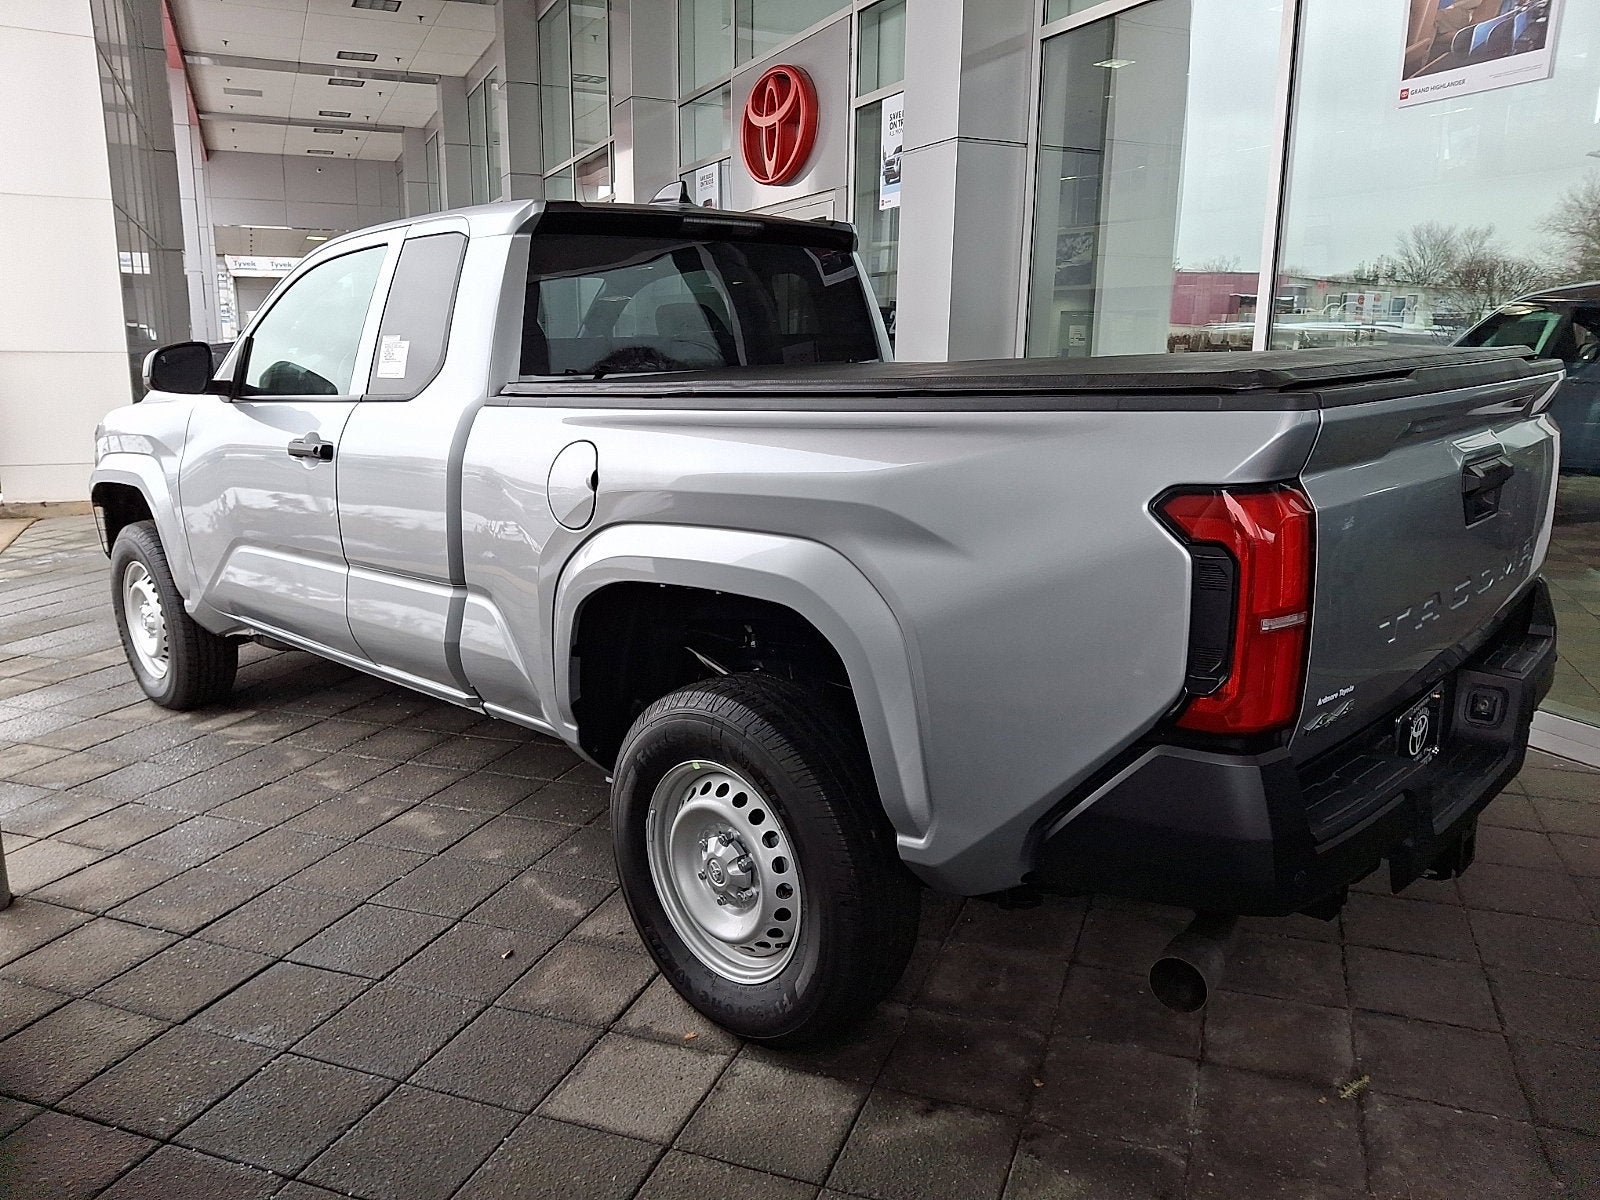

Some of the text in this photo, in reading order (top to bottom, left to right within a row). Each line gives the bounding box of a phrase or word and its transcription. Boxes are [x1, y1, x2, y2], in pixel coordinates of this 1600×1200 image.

[1410, 78, 1466, 96] GRAND HIGHLANDER
[889, 111, 902, 121] SAVE
[889, 122, 897, 131] ON
[233, 260, 256, 268] Tyvek
[1377, 535, 1534, 645] TACOMA
